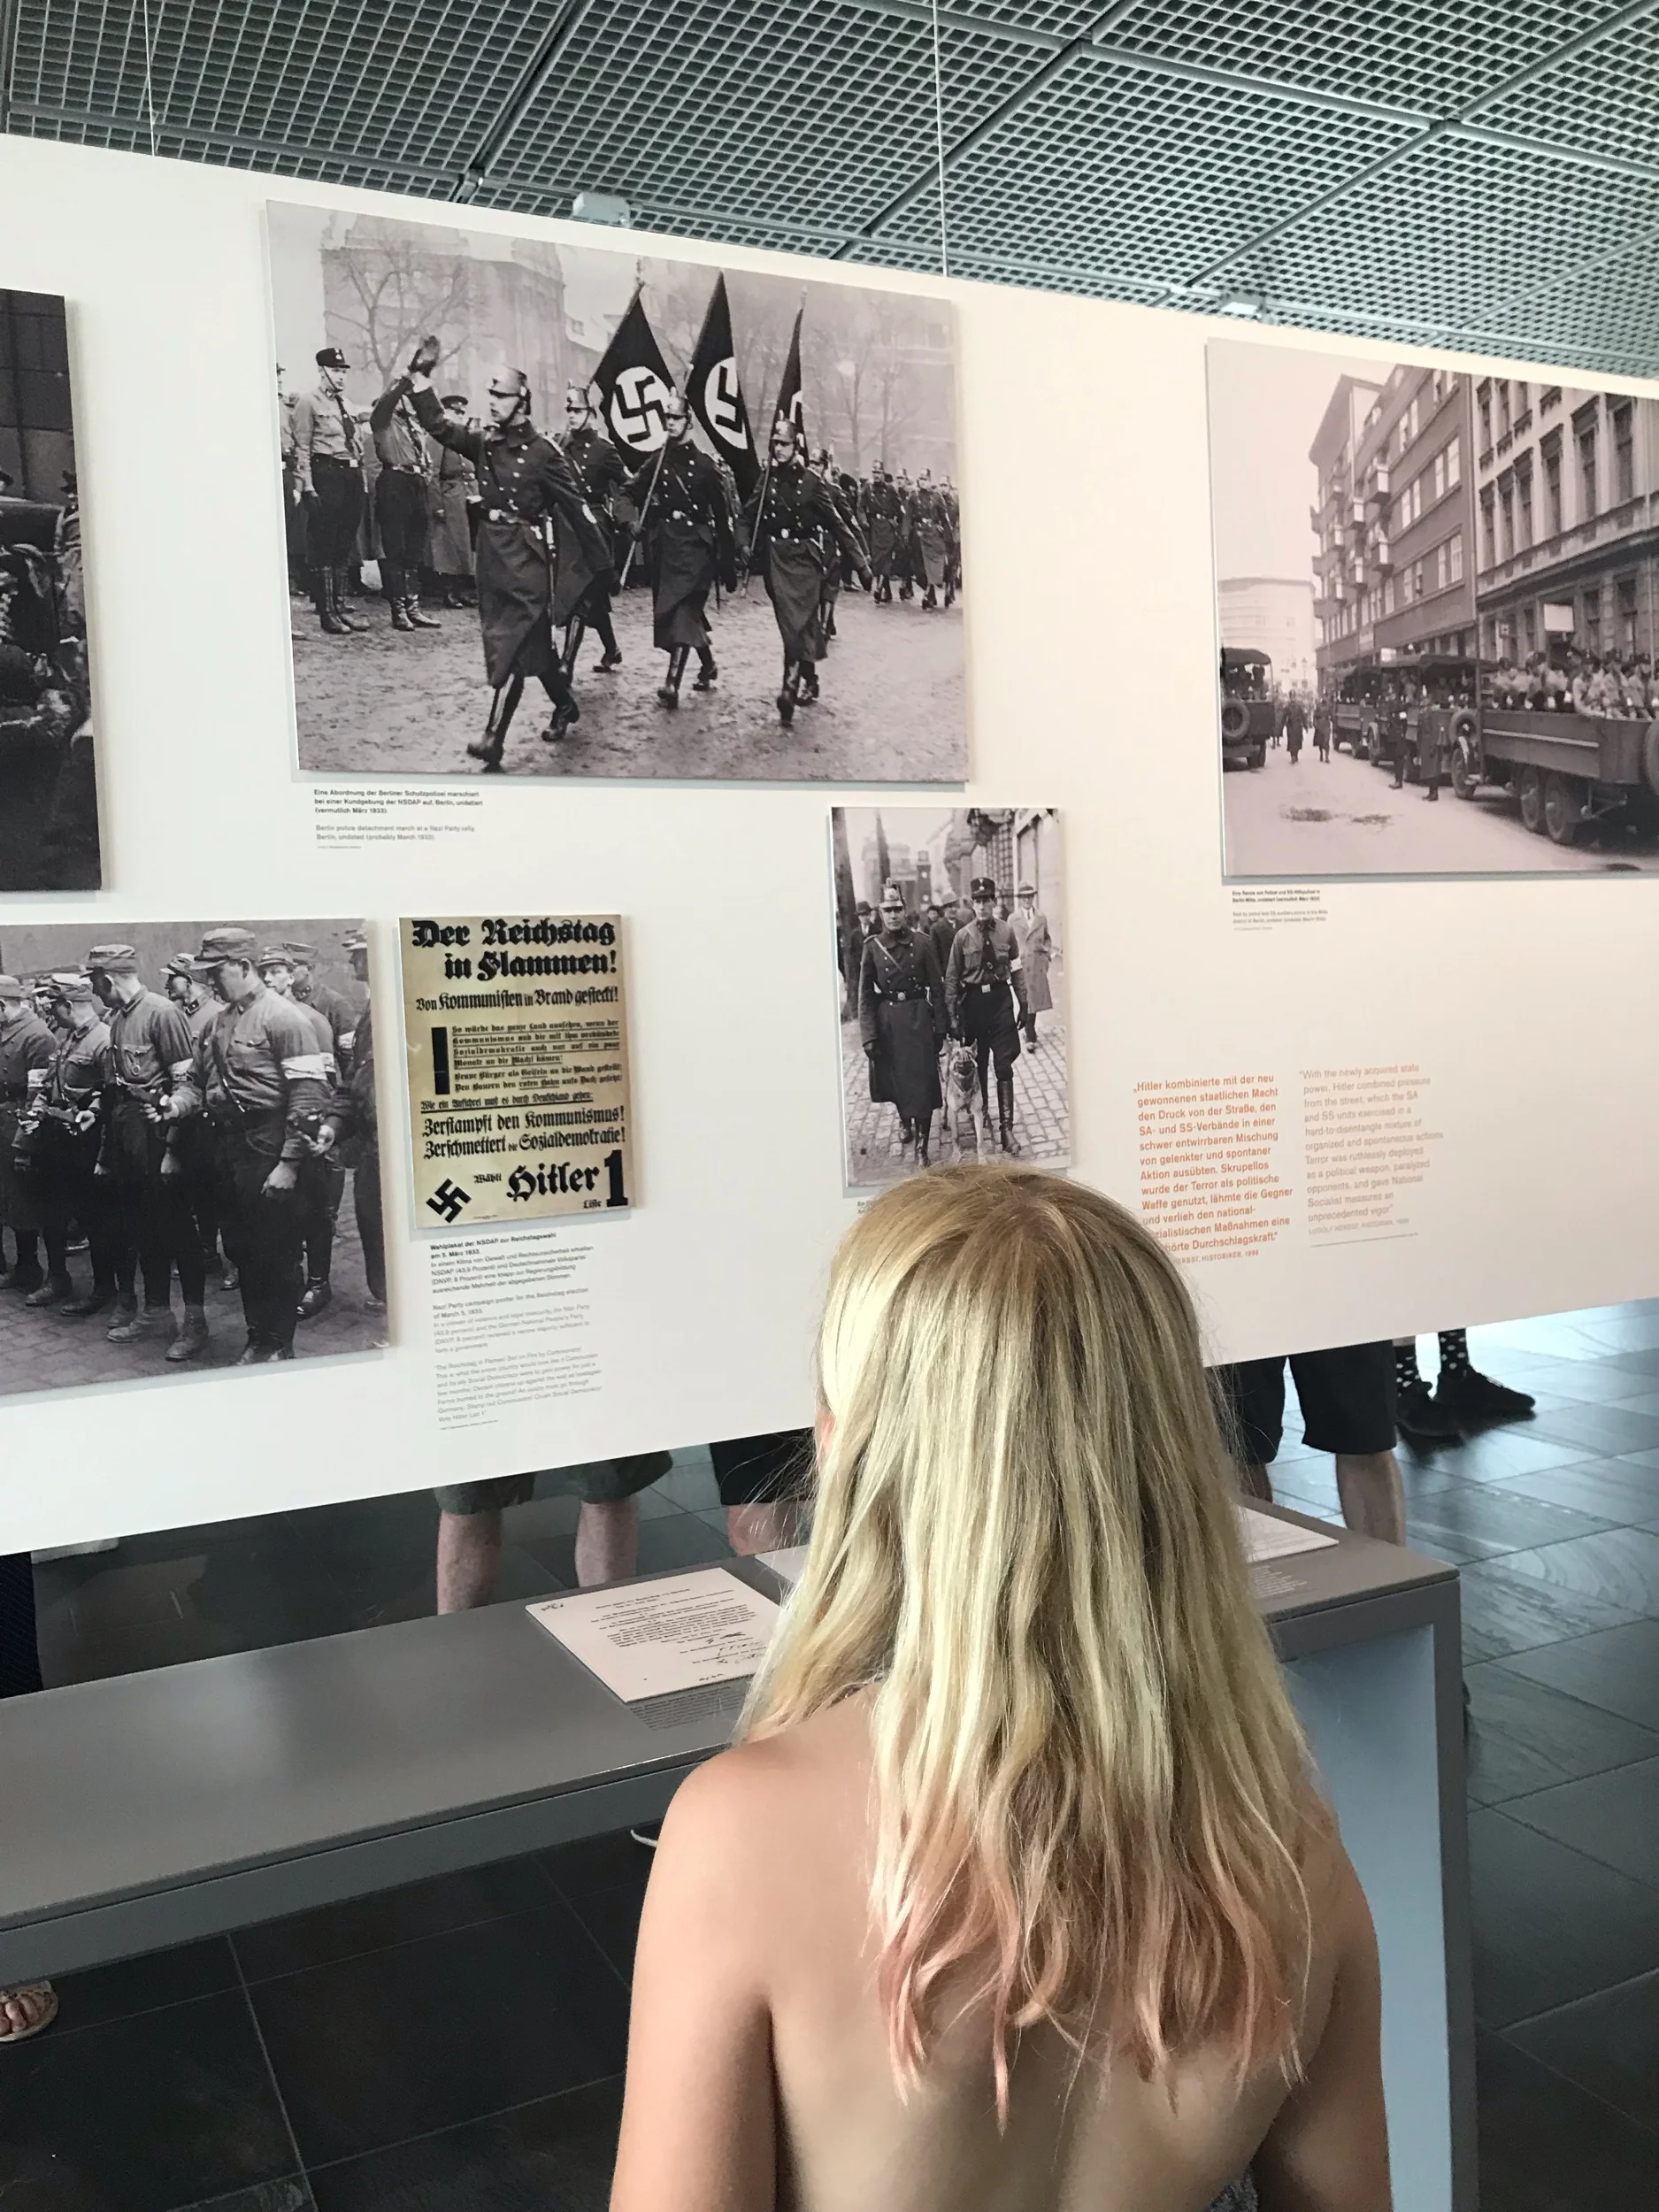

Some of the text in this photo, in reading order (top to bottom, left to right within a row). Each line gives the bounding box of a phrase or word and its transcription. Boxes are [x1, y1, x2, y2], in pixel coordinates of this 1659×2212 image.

[412, 918, 616, 949] Der Reichstag
[444, 949, 617, 981] in Flammen!
[417, 986, 619, 1010] Von Kommunisten in Brand gesteckt!
[1166, 1076, 1220, 1089] kombinierte
[1224, 1075, 1237, 1086] mit
[1240, 1073, 1255, 1085] der
[1258, 1075, 1274, 1084] neu
[1340, 1068, 1362, 1079] newly
[1364, 1065, 1399, 1078] acquired
[1402, 1064, 1420, 1072] state
[1304, 1078, 1431, 1095] power, Hitler combined pressure
[1138, 1087, 1279, 1108] gewonnenen staatlichen Macht
[1304, 1098, 1323, 1108] from
[1325, 1097, 1338, 1106] the
[1368, 1093, 1390, 1102] which
[1393, 1092, 1405, 1101] the
[1407, 1091, 1418, 1100] SA
[424, 1106, 625, 1137] Zerstampft den Kommunismus!
[1139, 1102, 1277, 1122] den Druck von der Straße, den
[1305, 1113, 1320, 1122] and
[1337, 1110, 1356, 1119] units
[1358, 1107, 1396, 1118] exercised
[1398, 1106, 1405, 1115] in
[1140, 1116, 1275, 1136] SA- und SS-Verbände in einer
[1306, 1122, 1382, 1138] hard-to-disentangle
[1385, 1119, 1412, 1129] mixture
[424, 1136, 507, 1160] Zerschmettert
[519, 1126, 626, 1152] Sozialdemokratie!
[1141, 1130, 1279, 1151] schwer entwirrbaren Mischung
[1306, 1140, 1345, 1153] organized
[1348, 1138, 1362, 1147] and
[1364, 1133, 1414, 1148] spontaneous
[1141, 1145, 1271, 1166] von gelenkter und spontaner
[1306, 1155, 1329, 1164] Terror
[1349, 1149, 1386, 1164] ruthlessly
[474, 1148, 628, 1207] Wählt Hitler 1
[1141, 1160, 1269, 1180] Aktion ausübten. Skrupellos
[1326, 1166, 1356, 1179] political
[1142, 1173, 1279, 1195] wurde der Terror als politische
[1308, 1173, 1424, 1195] opponents, and gave National
[583, 1198, 602, 1210] Liste
[1142, 1198, 1168, 1210] Waffe
[1171, 1194, 1208, 1210] genutzt,
[1211, 1191, 1241, 1204] lähmte
[1261, 1186, 1293, 1201] Gegner
[1309, 1196, 1342, 1207] Socialist
[1345, 1194, 1383, 1203] measures
[1143, 1204, 1256, 1225] und verlieh den national-
[1215, 1217, 1269, 1233] Maßnahmen
[1272, 1215, 1290, 1227] eine
[1309, 1207, 1369, 1224] unprecedented
[430, 1241, 463, 1252] Wahlplakat
[511, 1232, 556, 1244] Reichstagswahl
